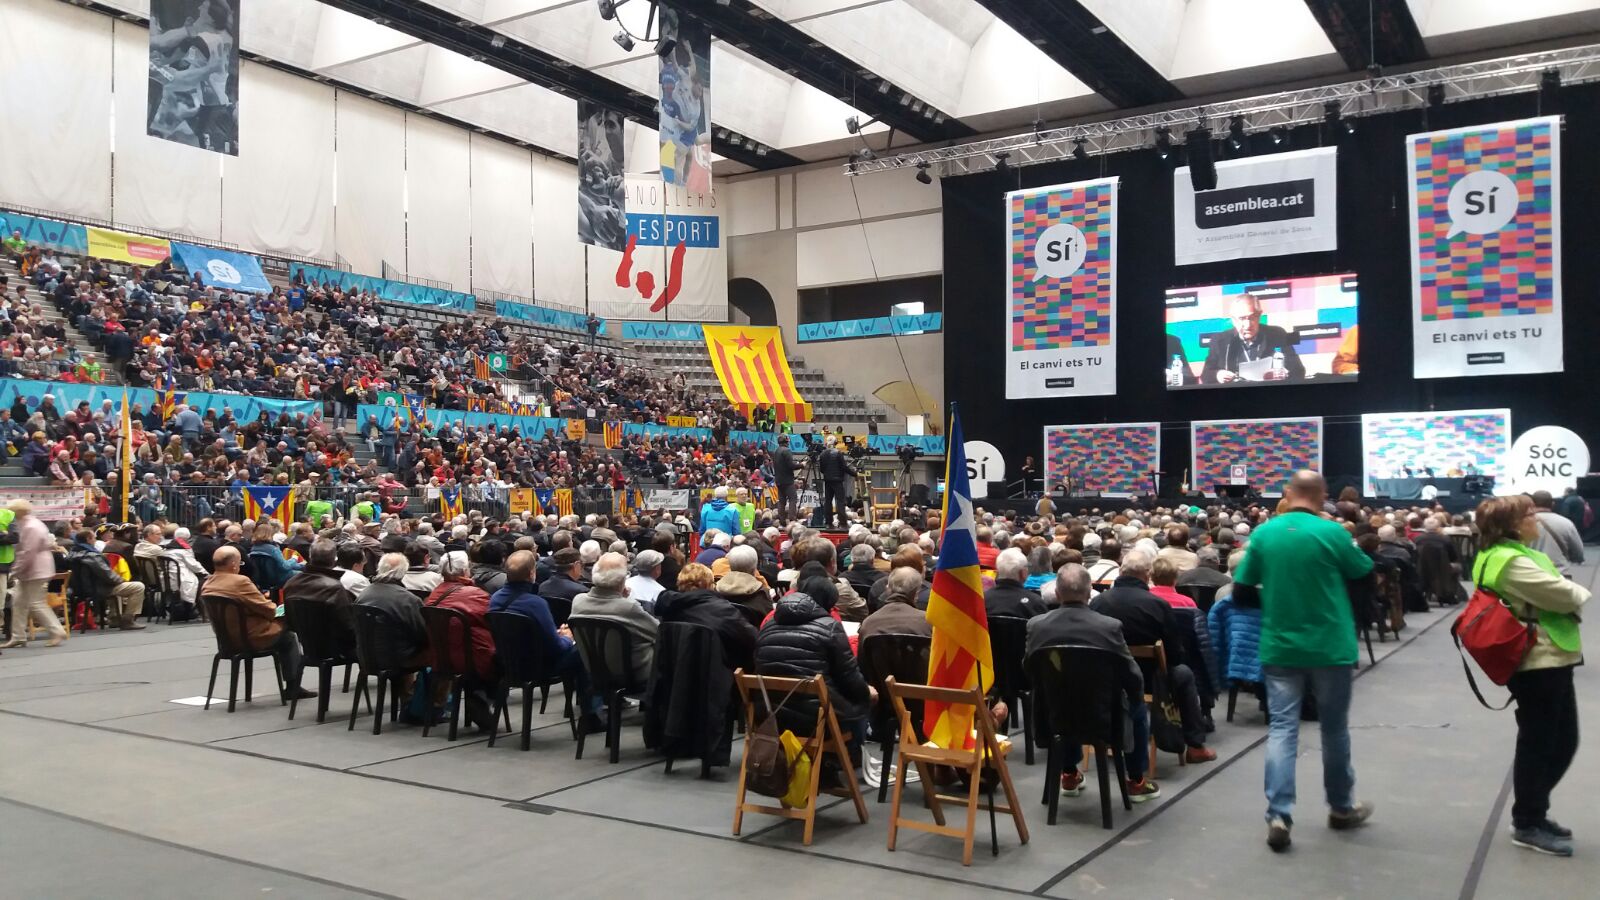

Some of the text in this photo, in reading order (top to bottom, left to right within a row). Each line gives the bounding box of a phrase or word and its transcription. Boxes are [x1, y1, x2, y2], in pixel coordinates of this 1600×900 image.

[1205, 192, 1304, 216] assemblea.cat
[1464, 186, 1500, 216] Sí
[639, 218, 712, 242] ESPORT
[1046, 237, 1073, 262] Sí
[1432, 327, 1543, 344] El canvi ets TU
[1020, 357, 1102, 370] El canvi ets TU
[1529, 443, 1567, 459] Sóc
[965, 456, 990, 480] Sí
[1524, 462, 1573, 477] ANC
